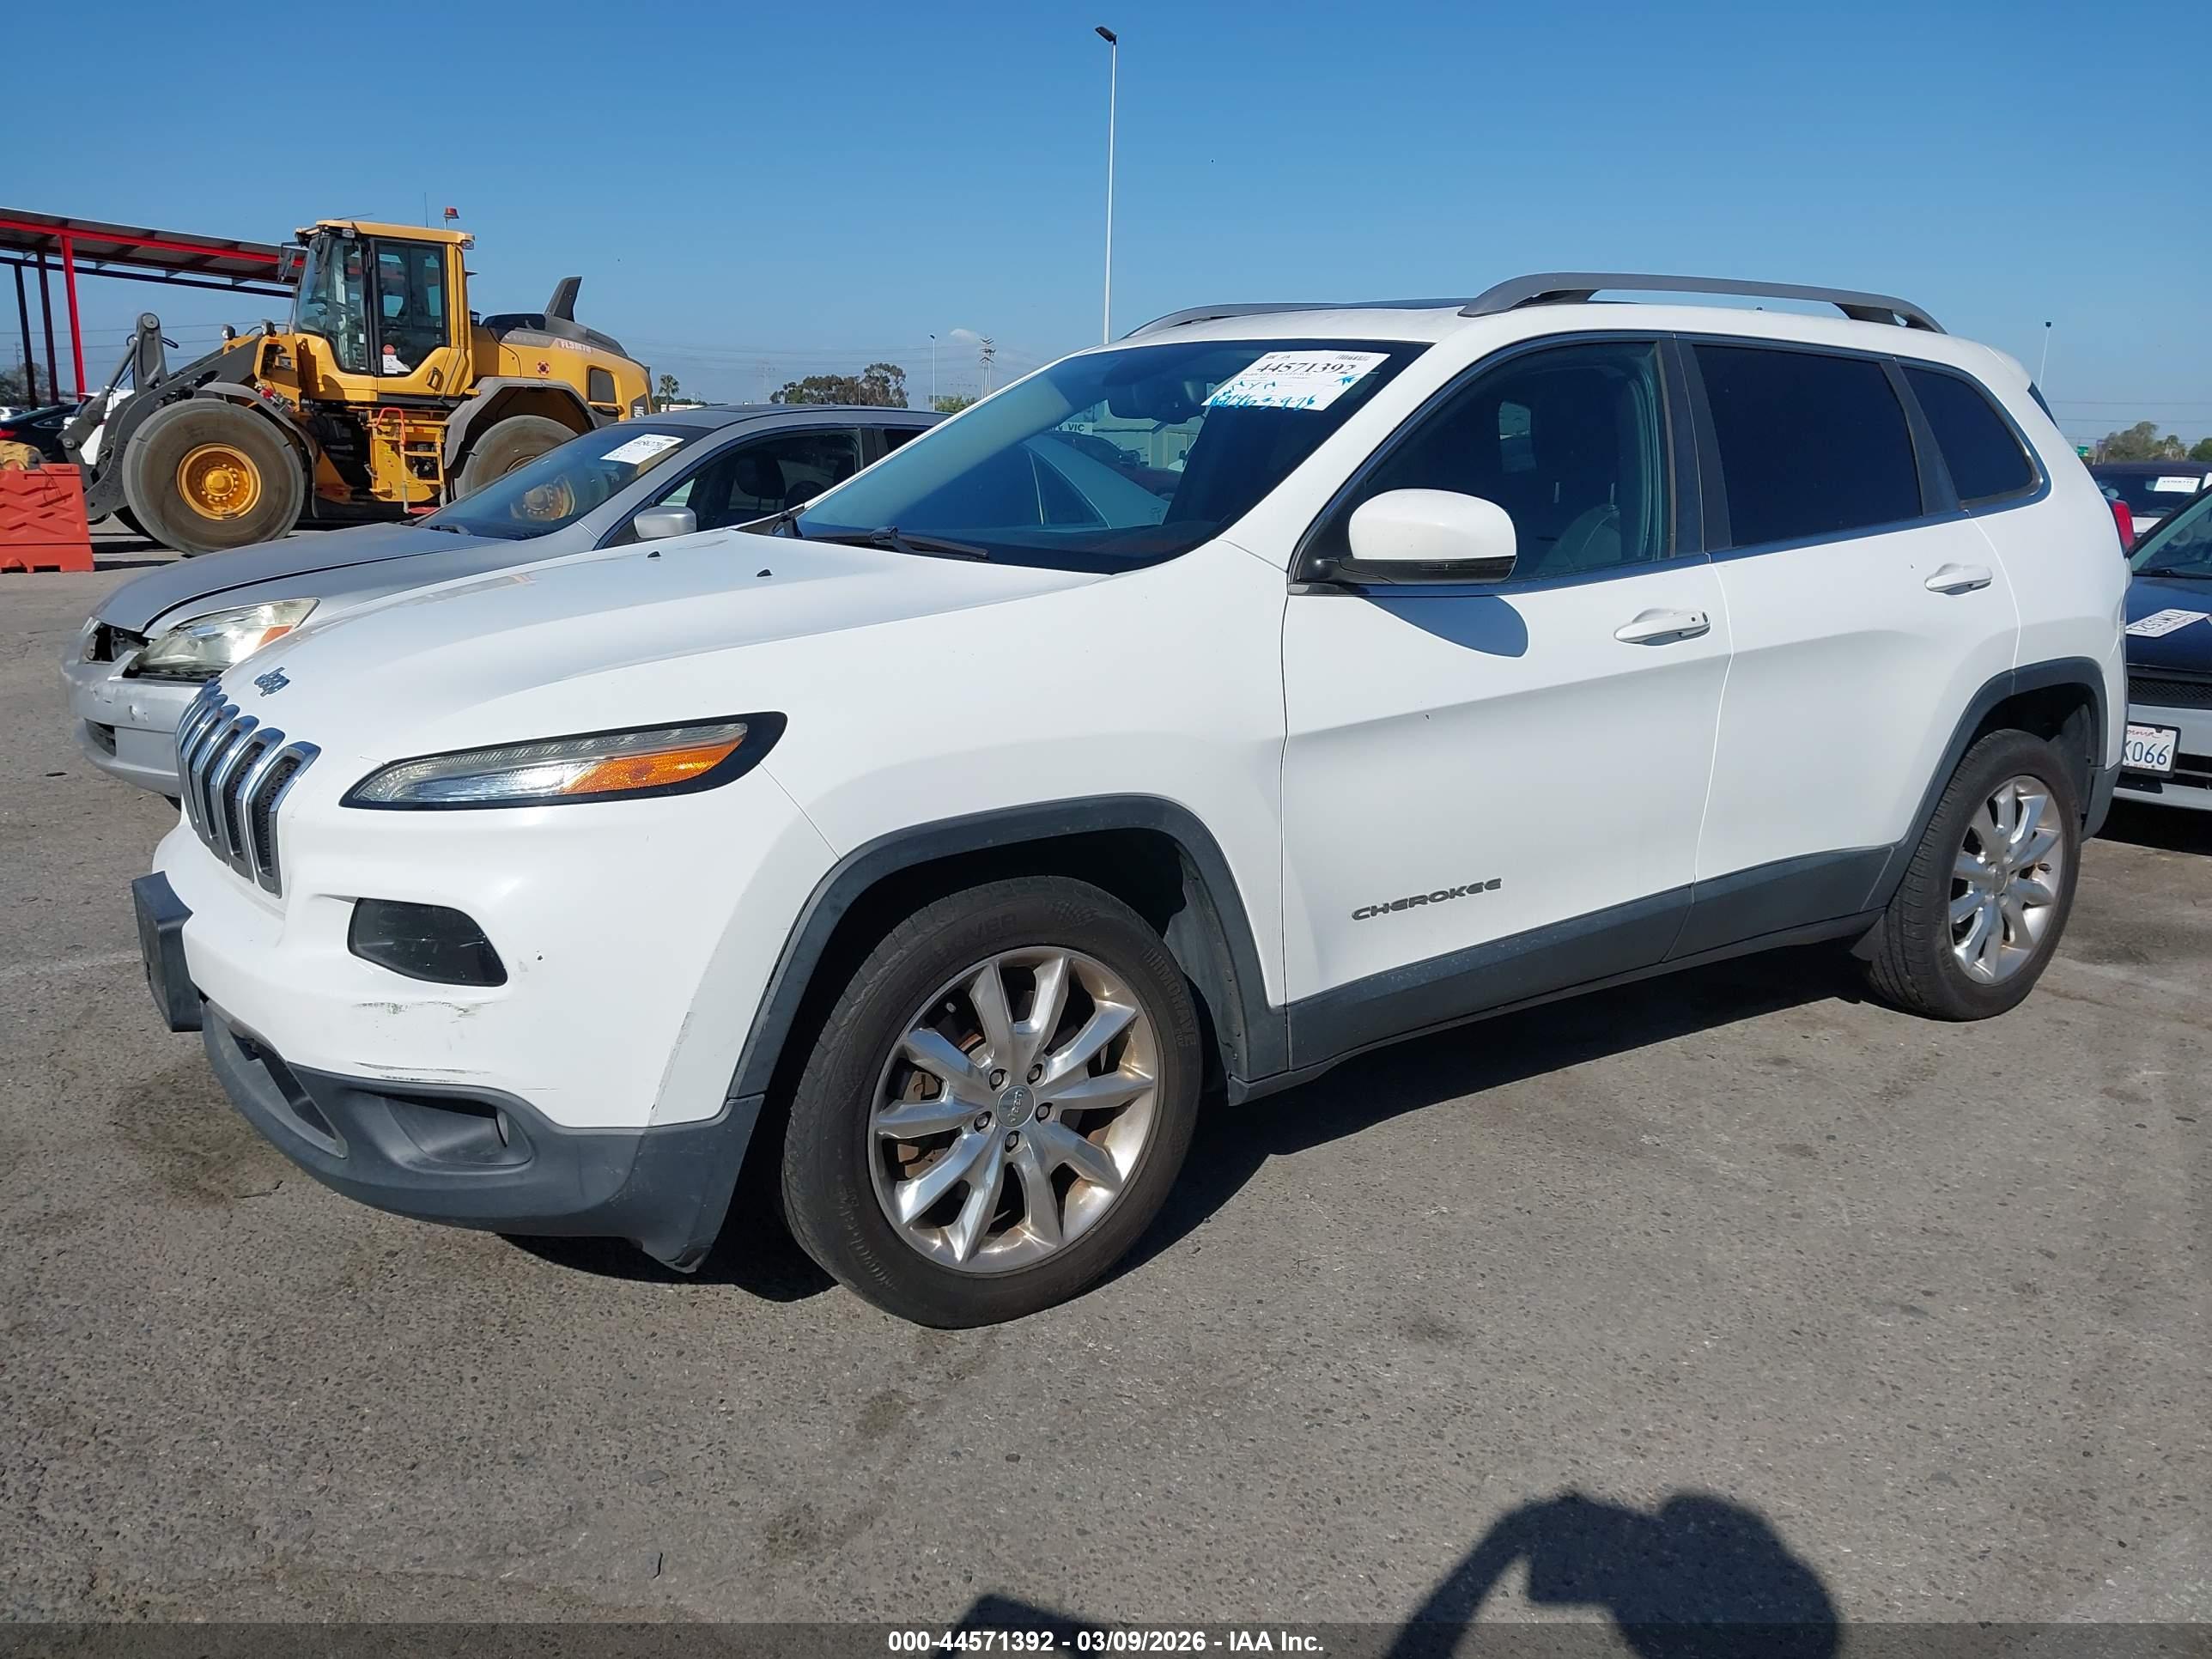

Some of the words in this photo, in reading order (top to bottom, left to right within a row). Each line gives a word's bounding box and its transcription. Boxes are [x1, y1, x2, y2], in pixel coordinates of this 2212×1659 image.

[1256, 362, 1357, 375] 44571392
[1067, 423, 1085, 432] VIC
[1352, 878, 1502, 921] CHEROKEE
